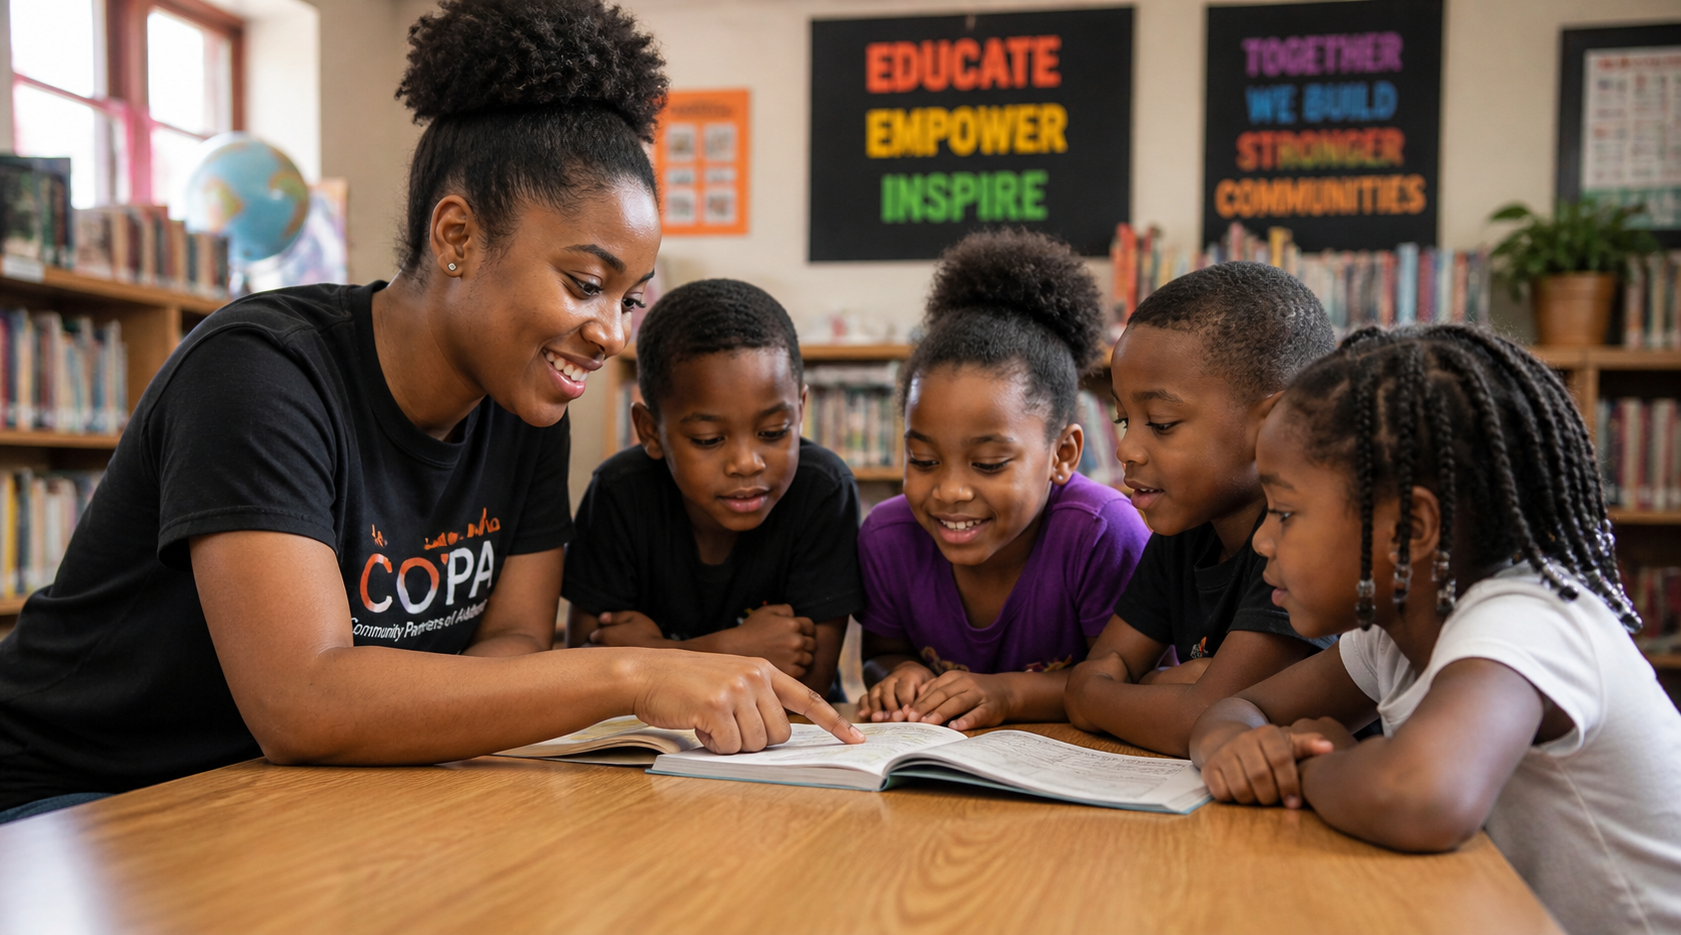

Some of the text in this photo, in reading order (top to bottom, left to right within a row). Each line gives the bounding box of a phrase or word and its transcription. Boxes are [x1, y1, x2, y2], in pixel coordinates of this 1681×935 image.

[865, 35, 1062, 94] EDUCATE
[1242, 32, 1404, 76] TOGETHER
[1245, 81, 1398, 124] WE BUILD
[865, 103, 1068, 159] EMPOWER
[1235, 127, 1406, 172] STRONGER
[880, 170, 1049, 223] INSPIRE
[1215, 174, 1427, 218] COMMUNITIES
